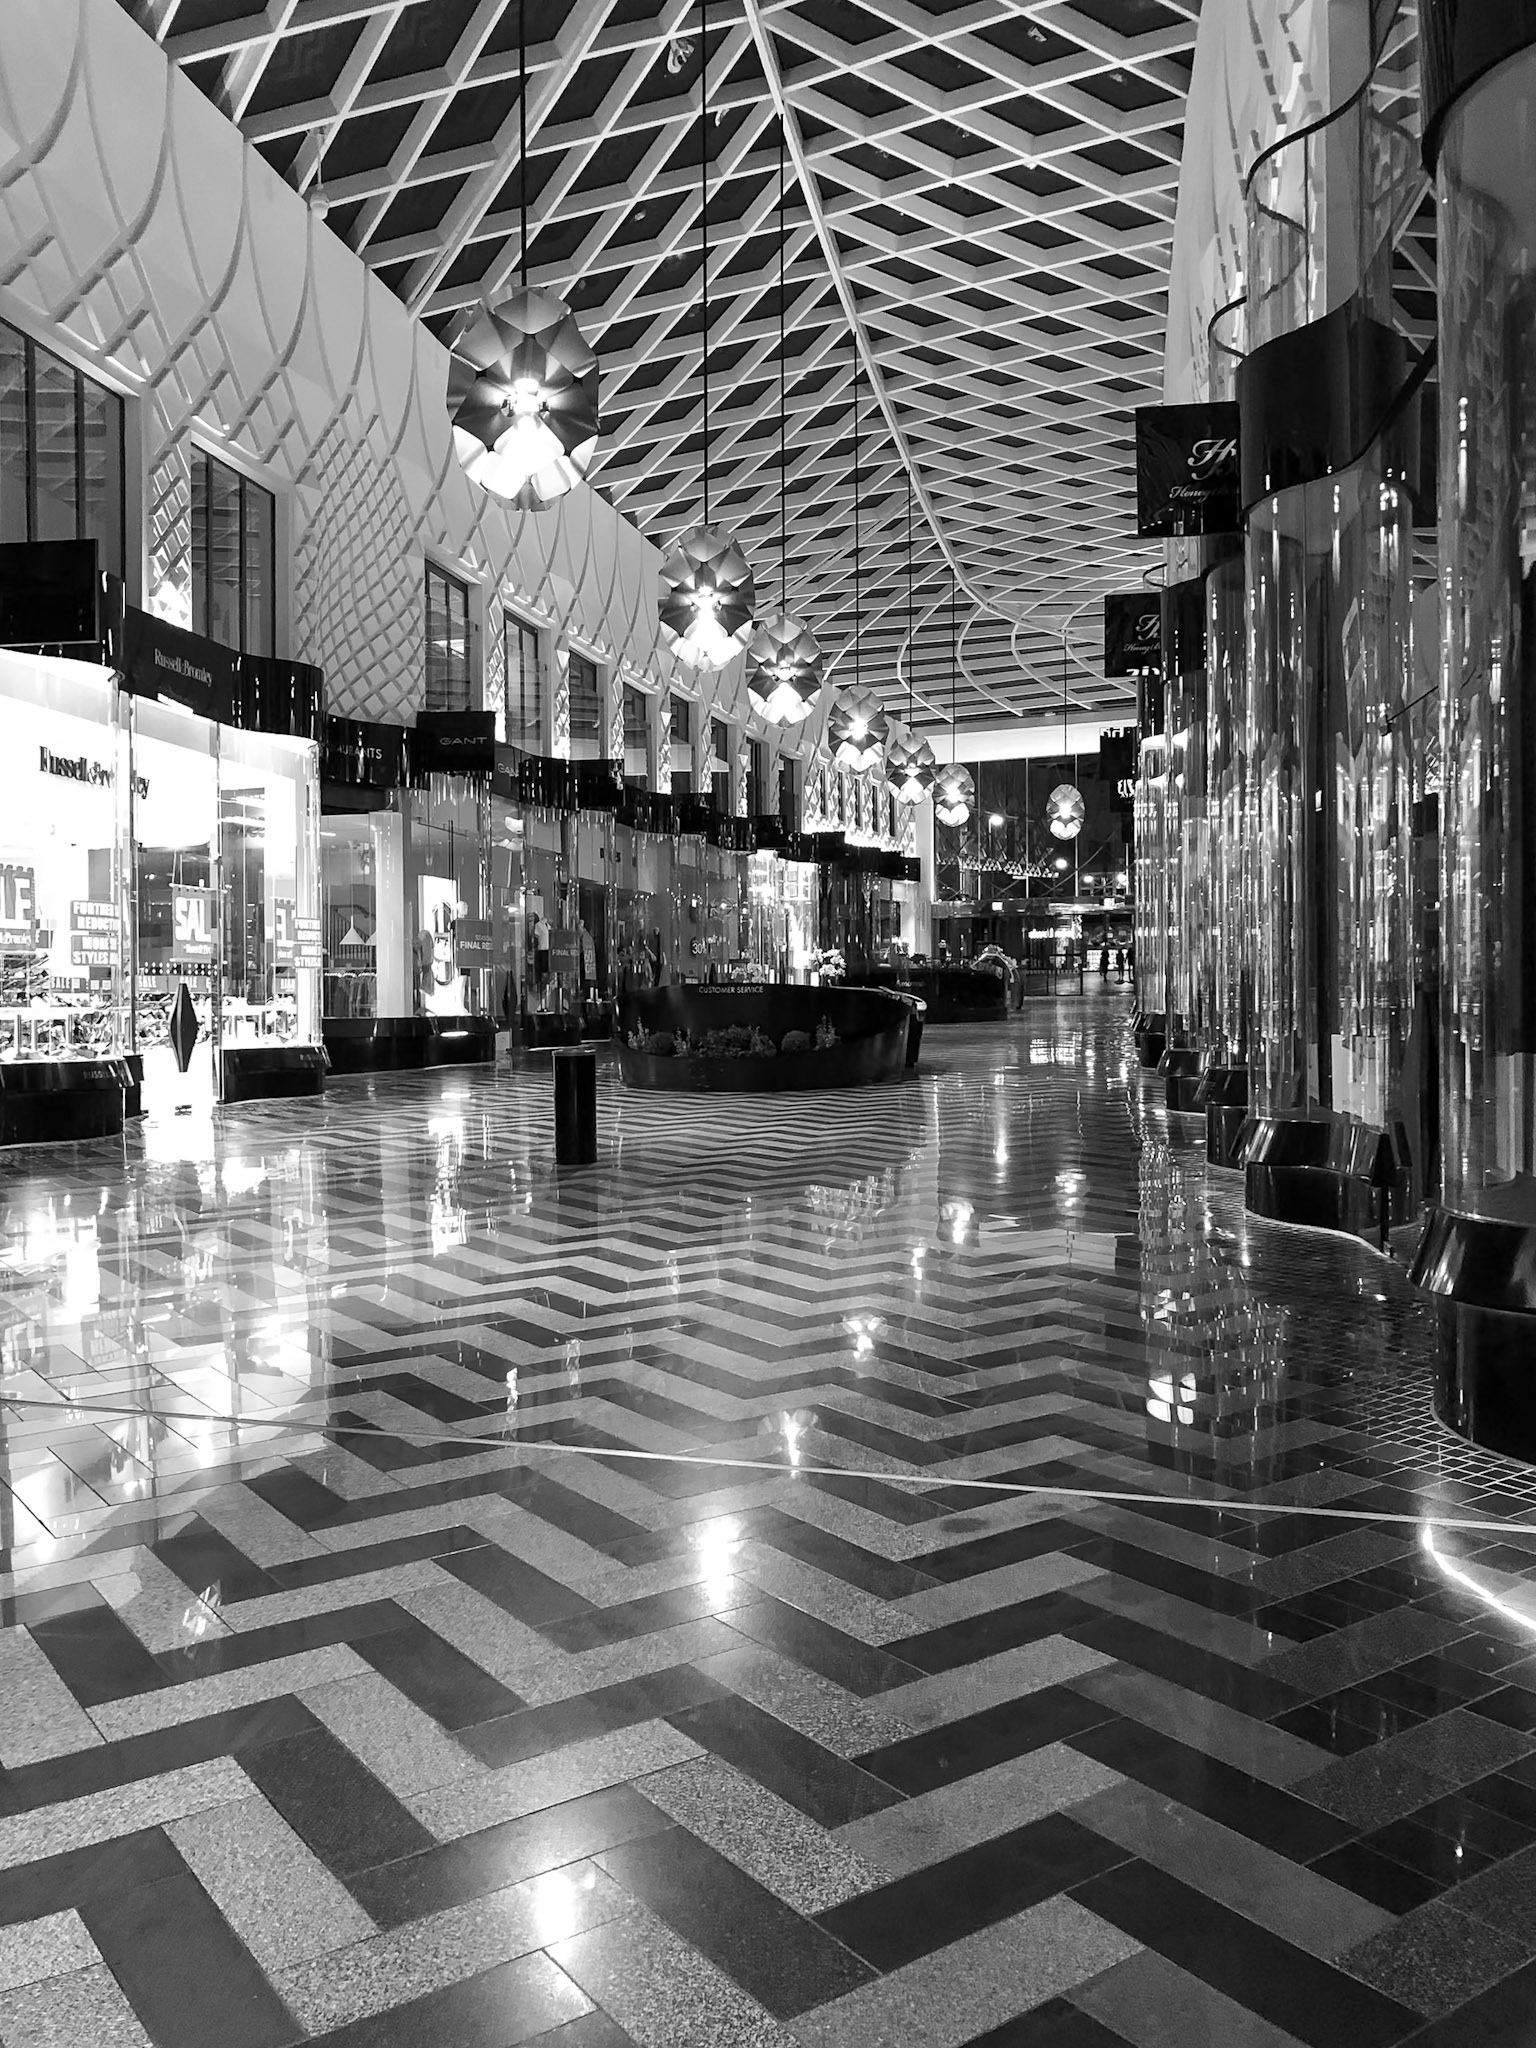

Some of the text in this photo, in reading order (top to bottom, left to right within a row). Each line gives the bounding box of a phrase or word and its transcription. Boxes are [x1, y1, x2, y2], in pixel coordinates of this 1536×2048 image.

[439, 736, 488, 746] GANT
[497, 762, 520, 778] GAN
[175, 896, 212, 943] SAL
[460, 940, 481, 950] FINAL
[72, 950, 108, 965] STYLES
[552, 949, 570, 957] FINAL
[698, 985, 764, 994] CUSTOMER SERVICE
